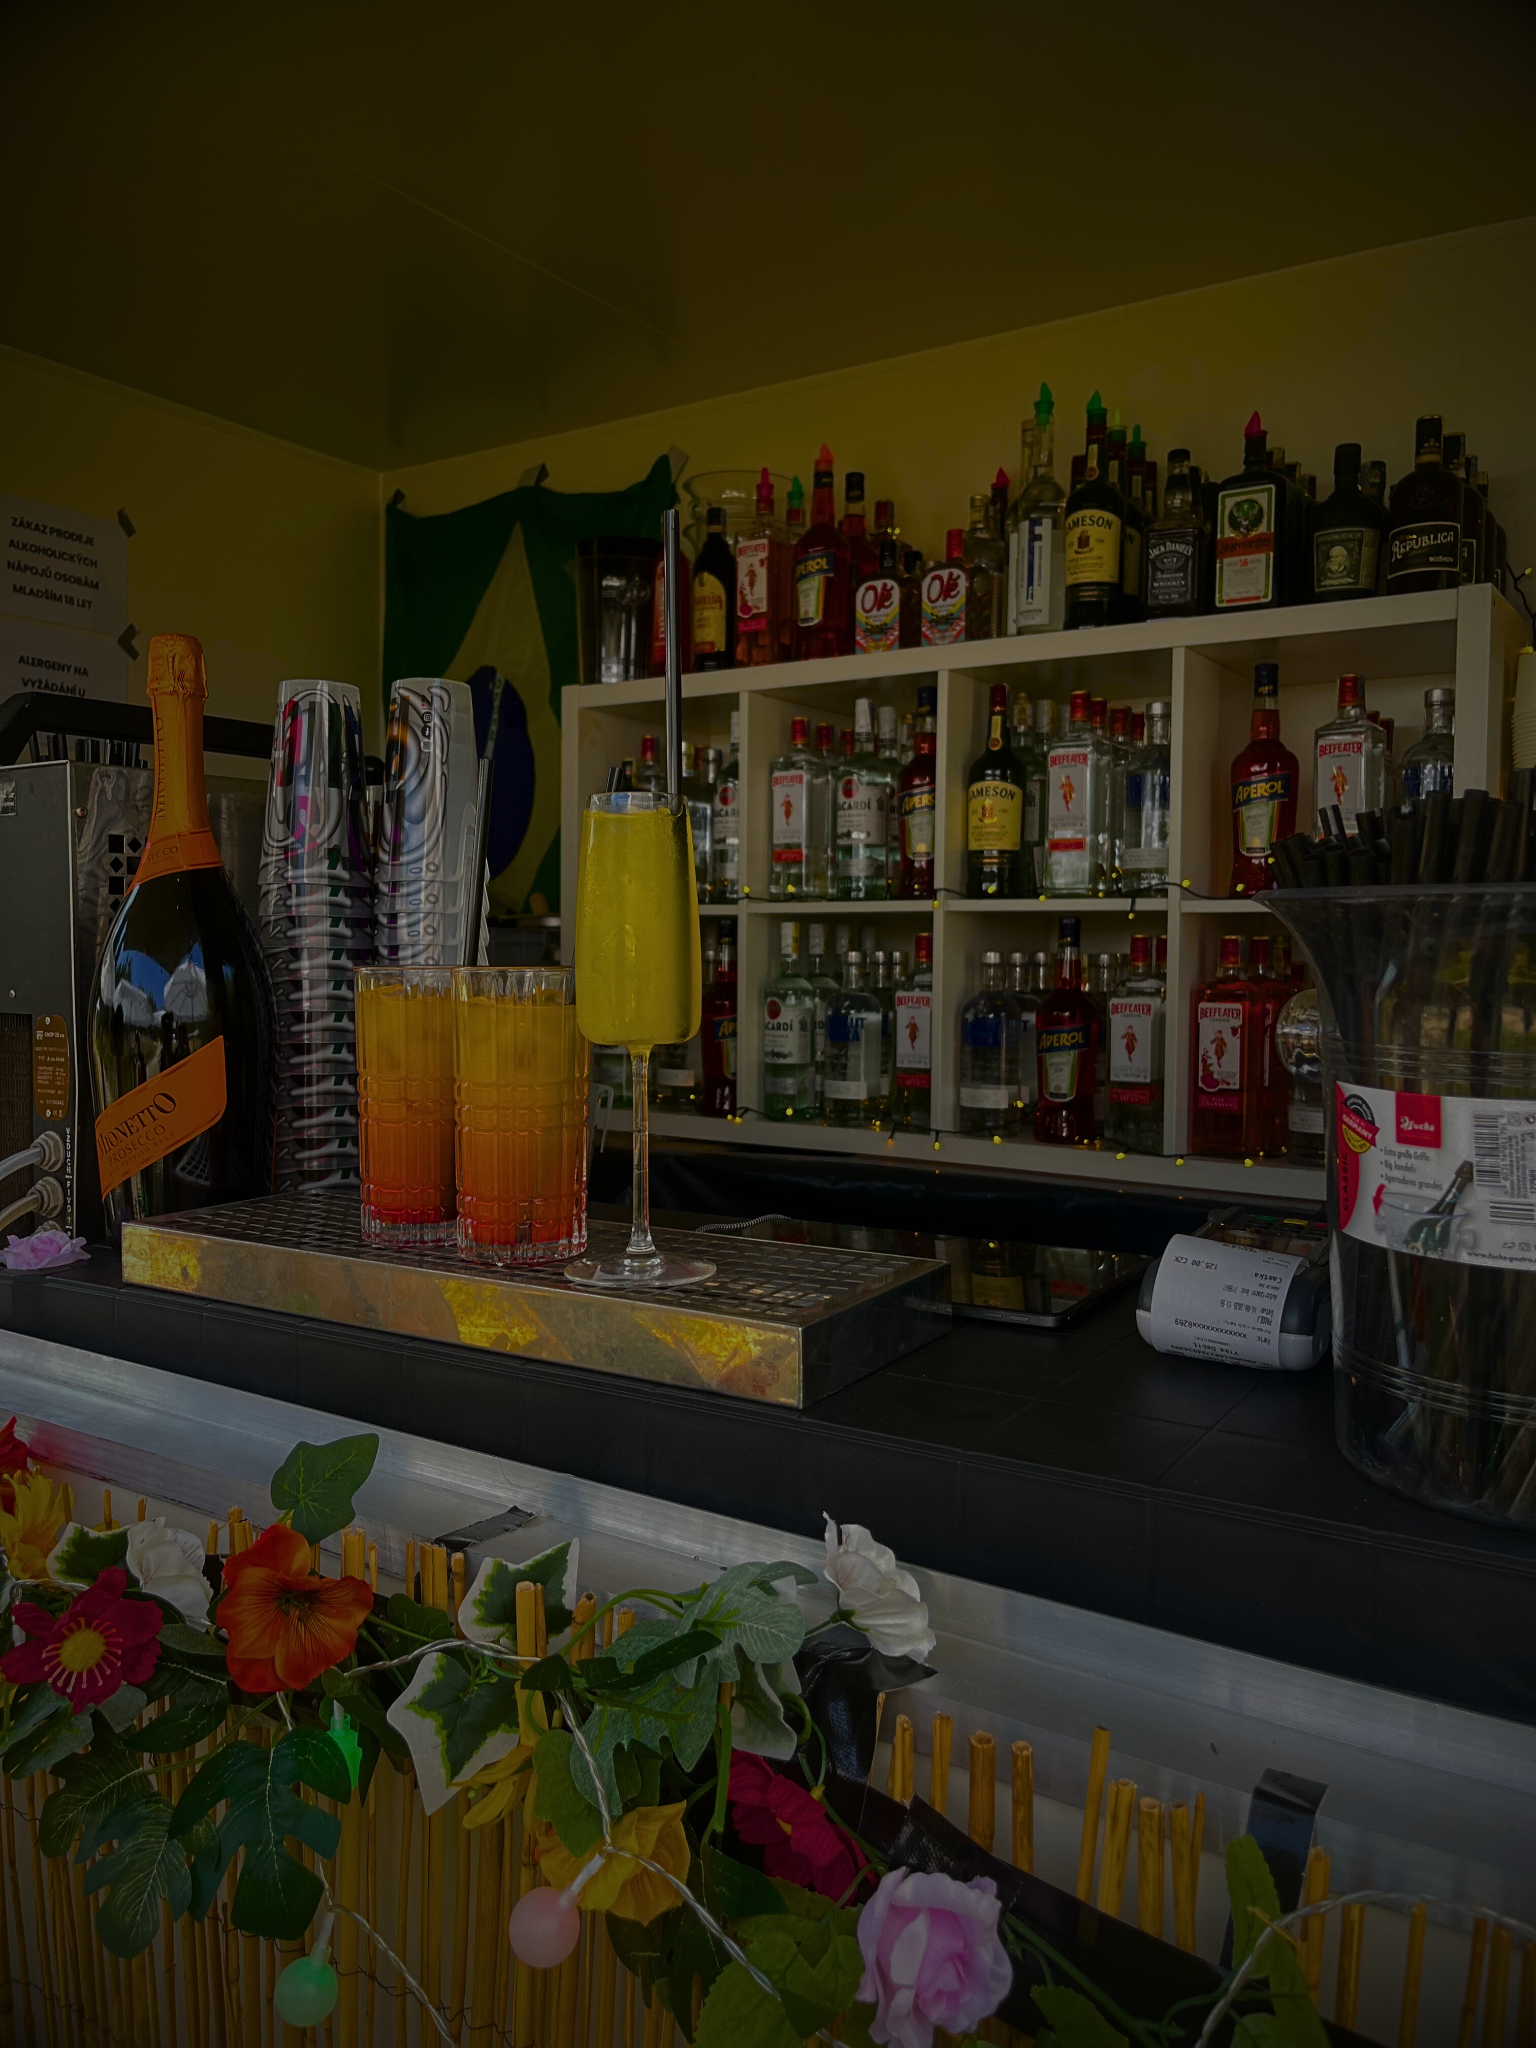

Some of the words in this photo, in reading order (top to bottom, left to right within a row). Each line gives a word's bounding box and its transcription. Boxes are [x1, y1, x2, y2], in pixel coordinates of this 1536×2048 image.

[11, 516, 48, 535] ZÁKAZ
[50, 527, 95, 547] PRODEJE
[8, 538, 99, 569] ALKOHOLICKÝCH
[7, 559, 52, 579] NÁPOJŮ
[53, 570, 100, 590] OSOBÁM
[13, 583, 63, 604] MLADŠÍM
[64, 594, 75, 606] 18
[76, 599, 93, 610] LET
[18, 654, 73, 674] ALERGENY
[73, 666, 89, 678] NA
[21, 677, 77, 697] VYŽÁDÁNÍ
[78, 687, 86, 697] U
[1319, 741, 1362, 758] BEEFEATER
[1049, 752, 1089, 768] BEEFEATER
[1235, 779, 1285, 805] APEROL
[896, 995, 931, 1009] BEEFEATER
[1111, 1002, 1152, 1016] BEEFEATER
[1199, 1006, 1242, 1021] BEEFEATER
[1039, 1029, 1085, 1049] APEROL
[108, 1124, 166, 1168] PROSECCO
[153, 1131, 175, 1148] BRUT
[1341, 1151, 1349, 1212] CLASSIC
[1173, 1255, 1188, 1265] CZK
[1193, 1341, 1217, 1353] Debit
